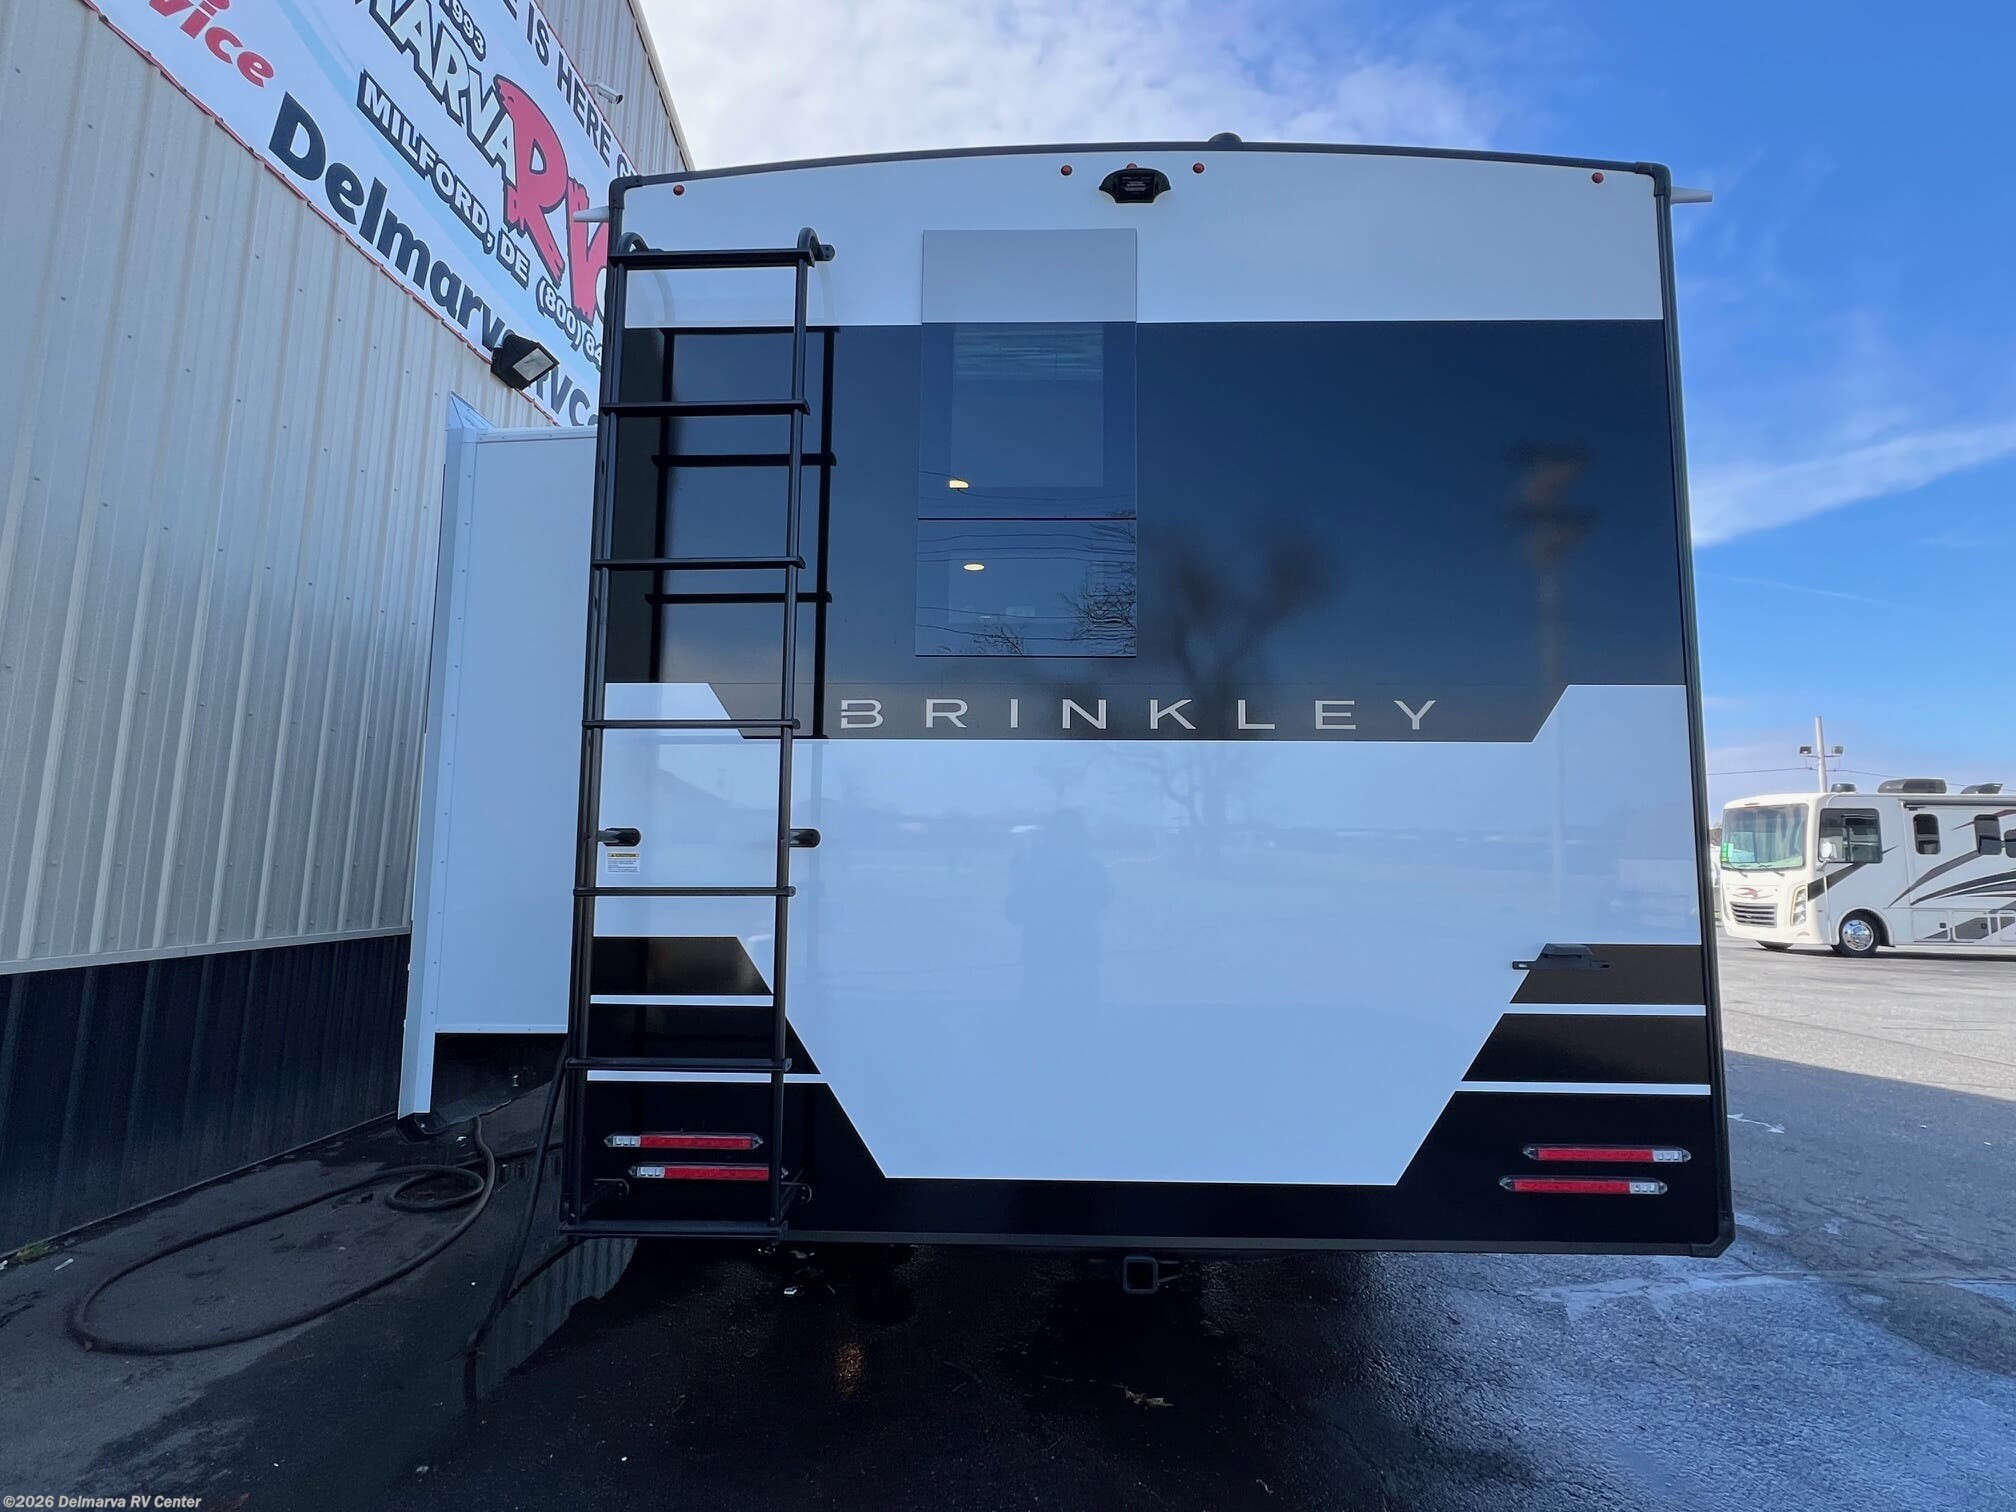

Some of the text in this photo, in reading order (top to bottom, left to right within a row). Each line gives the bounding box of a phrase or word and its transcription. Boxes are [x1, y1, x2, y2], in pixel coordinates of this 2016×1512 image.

[527, 1, 612, 168] IS HERE
[357, 69, 495, 254] MILFORD,
[497, 226, 531, 291] DE
[536, 276, 582, 352] (800)
[840, 698, 1437, 731] BRINKLEY
